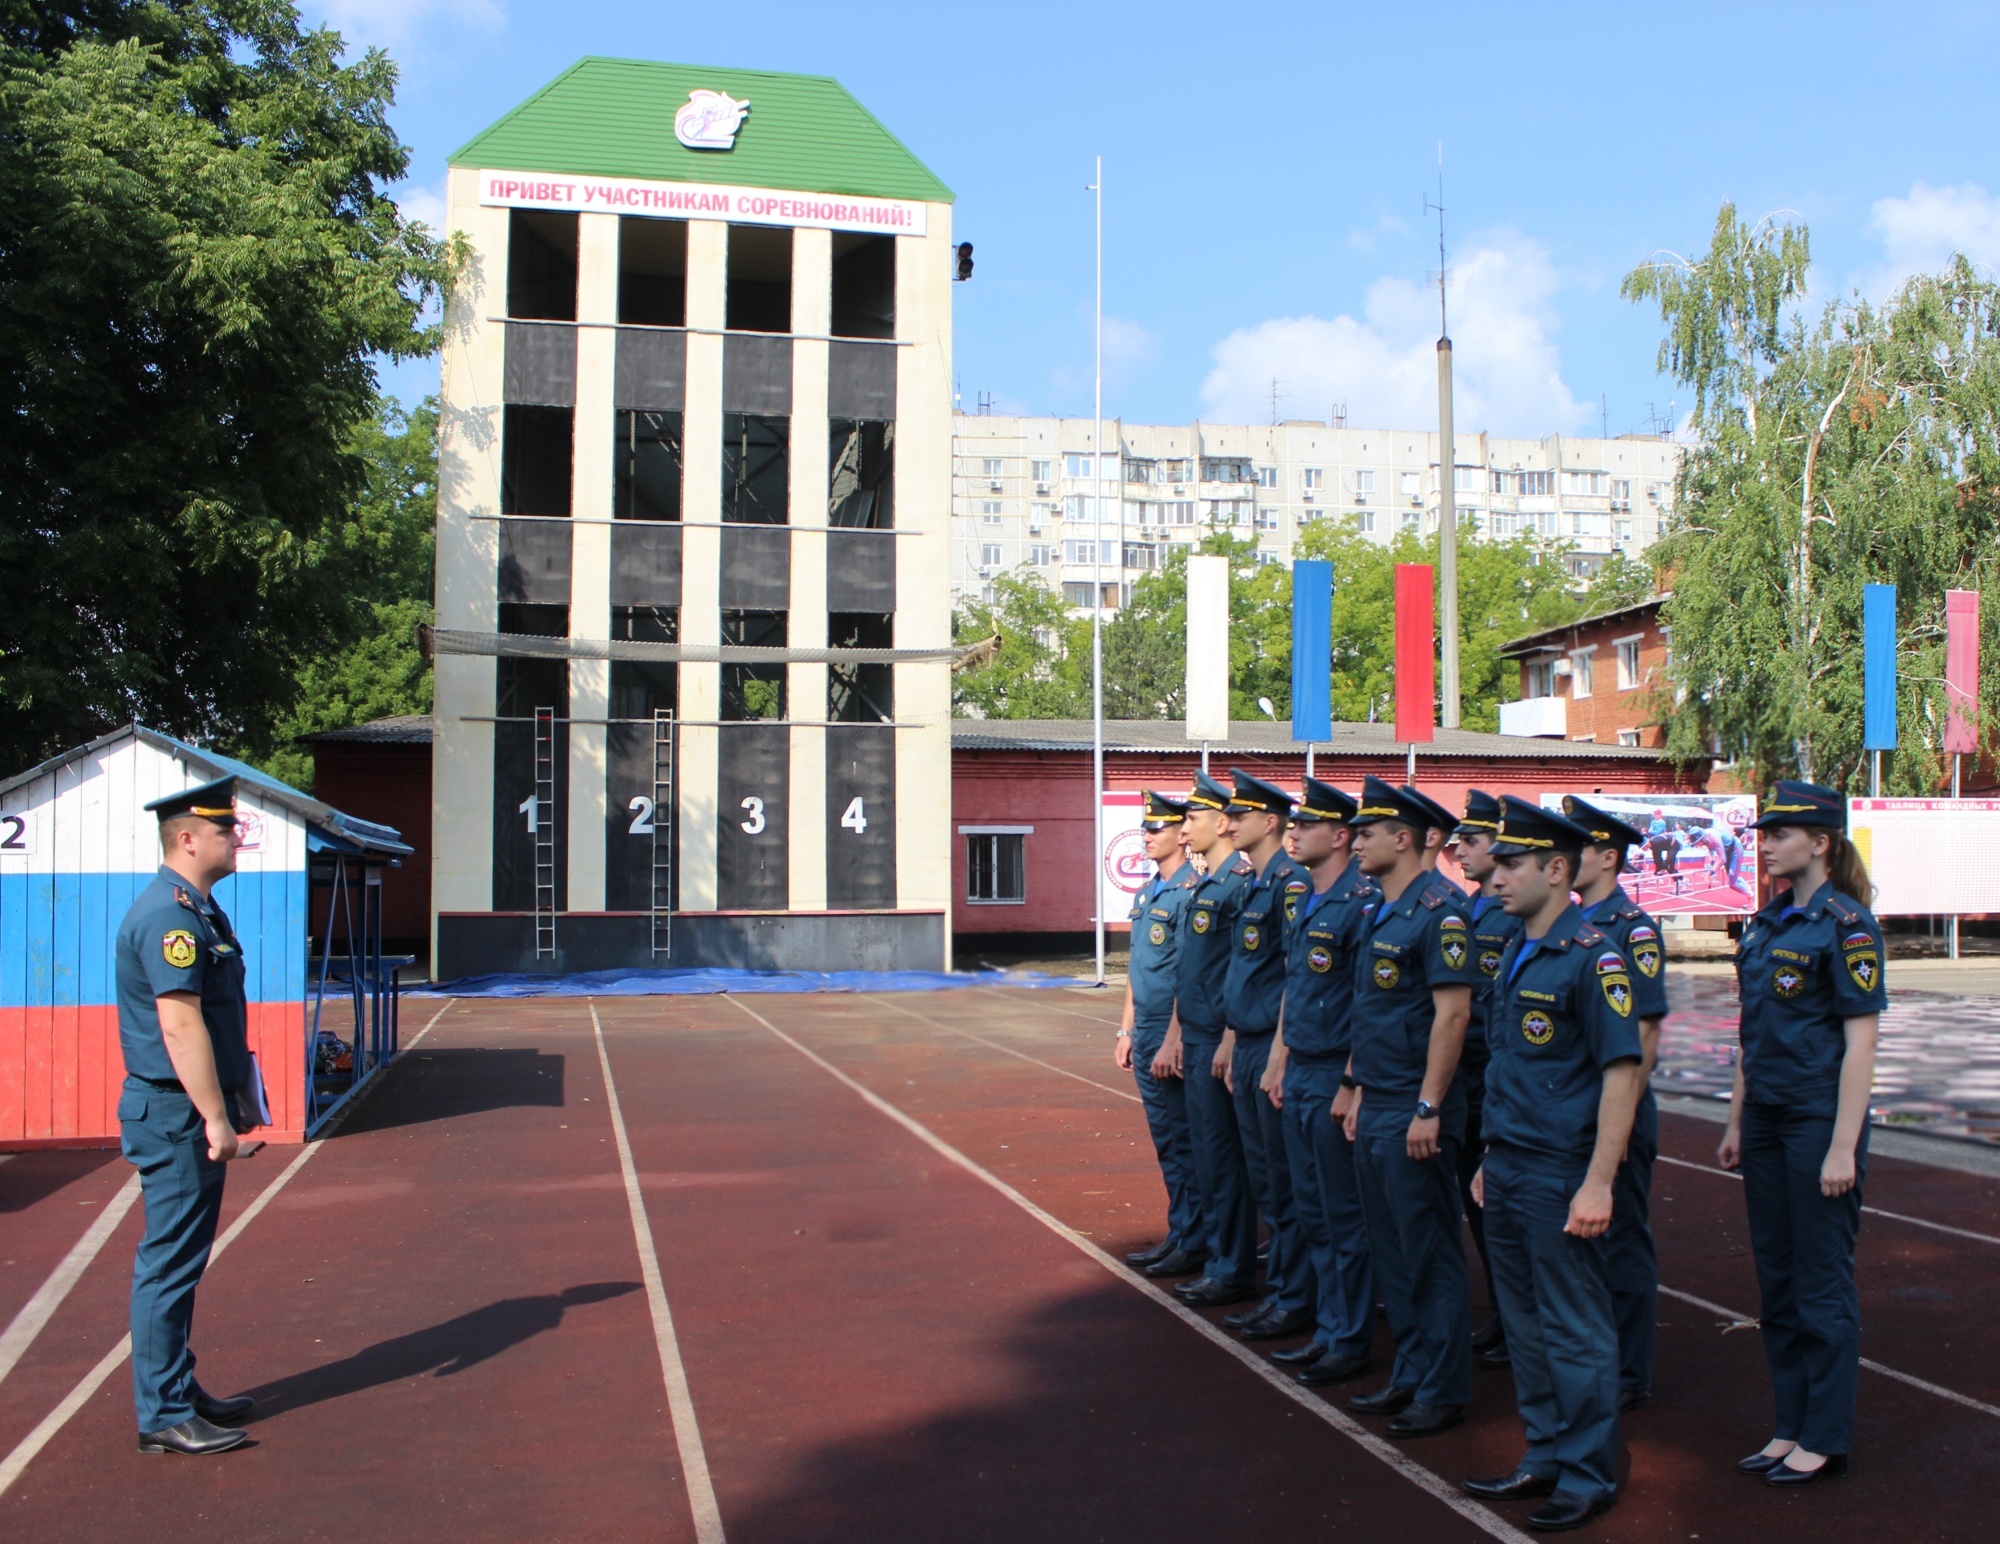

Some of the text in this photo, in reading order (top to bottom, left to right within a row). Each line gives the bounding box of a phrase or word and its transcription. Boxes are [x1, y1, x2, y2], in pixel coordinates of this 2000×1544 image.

[490, 179, 912, 226] ПРИВЕТ УЧАСТНИКАМ СОРЕВНОВАНИЙ!
[518, 794, 537, 833] 1
[628, 796, 653, 834] 2
[740, 796, 765, 834] 3
[841, 796, 867, 833] 4
[1884, 801, 1927, 811] ТАБЛИЦА
[1931, 801, 1988, 811] КОМАНДНЫХ
[1, 816, 26, 849] 2
